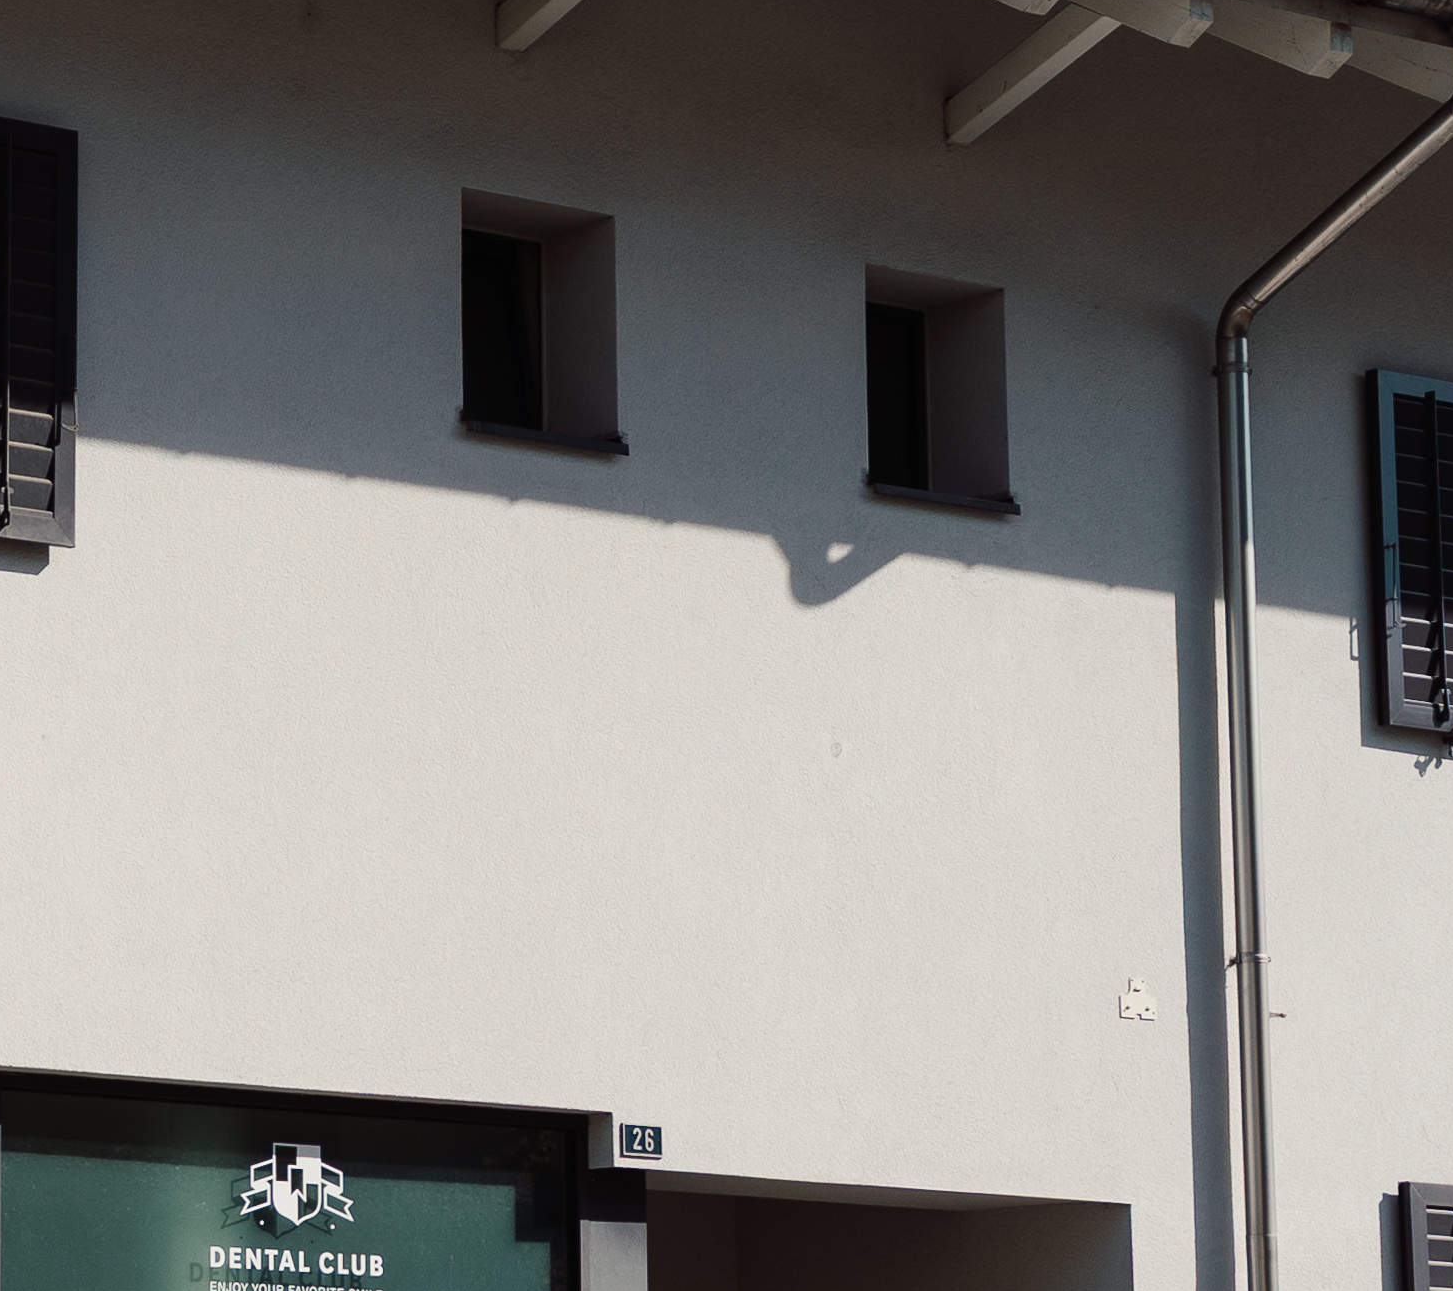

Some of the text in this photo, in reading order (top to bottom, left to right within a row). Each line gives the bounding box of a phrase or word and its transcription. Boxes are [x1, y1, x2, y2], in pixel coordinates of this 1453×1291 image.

[632, 1127, 654, 1152] 26
[209, 1246, 384, 1277] DENTAL CLUB
